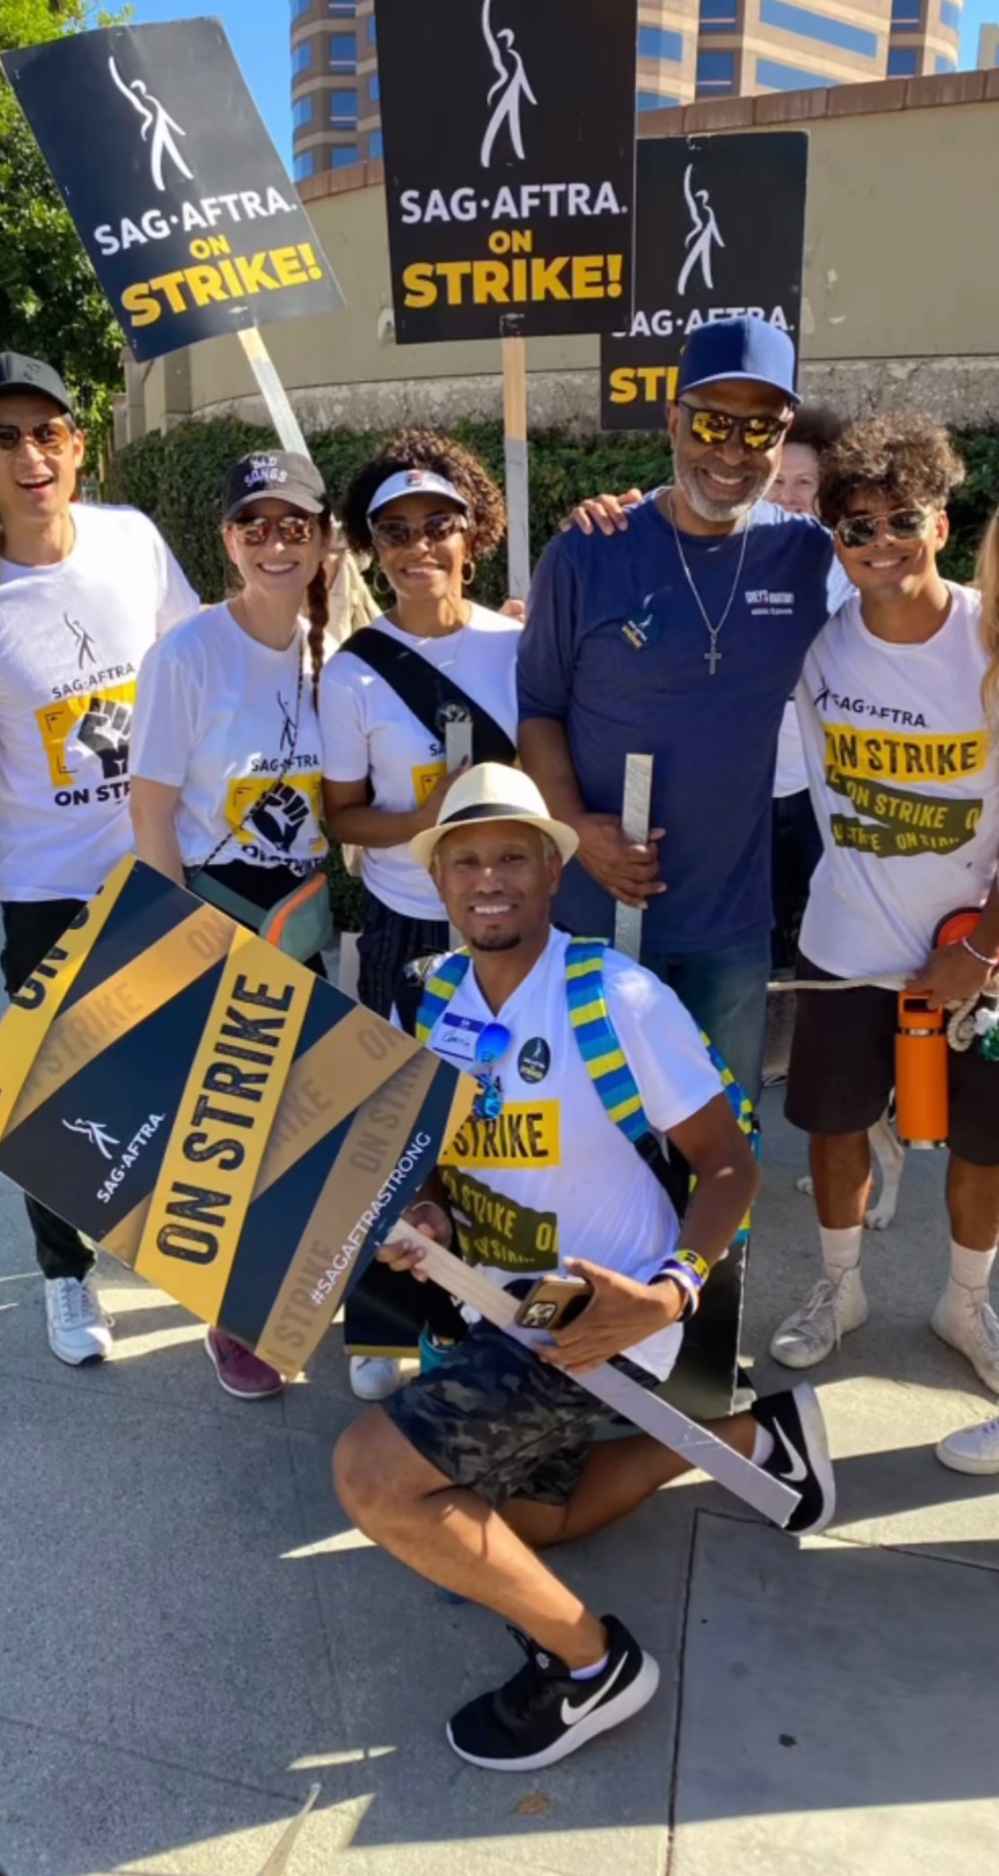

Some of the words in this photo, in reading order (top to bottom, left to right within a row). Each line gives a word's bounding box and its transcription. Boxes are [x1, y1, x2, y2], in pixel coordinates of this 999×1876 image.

[189, 234, 231, 260] ON
[488, 229, 532, 254] ON
[120, 243, 322, 328] STRIKE!
[402, 254, 623, 308] STRIKE!
[612, 305, 795, 337] AG·AA.
[864, 738, 978, 775] STRIKE
[54, 787, 90, 807] ON
[873, 793, 950, 830] STRIKE
[182, 974, 295, 1171] STRIKE
[349, 1132, 391, 1175] ON
[156, 1181, 232, 1265] ON
[310, 1131, 431, 1306] #SAGAFTRASTRONG
[535, 1222, 558, 1253] O
